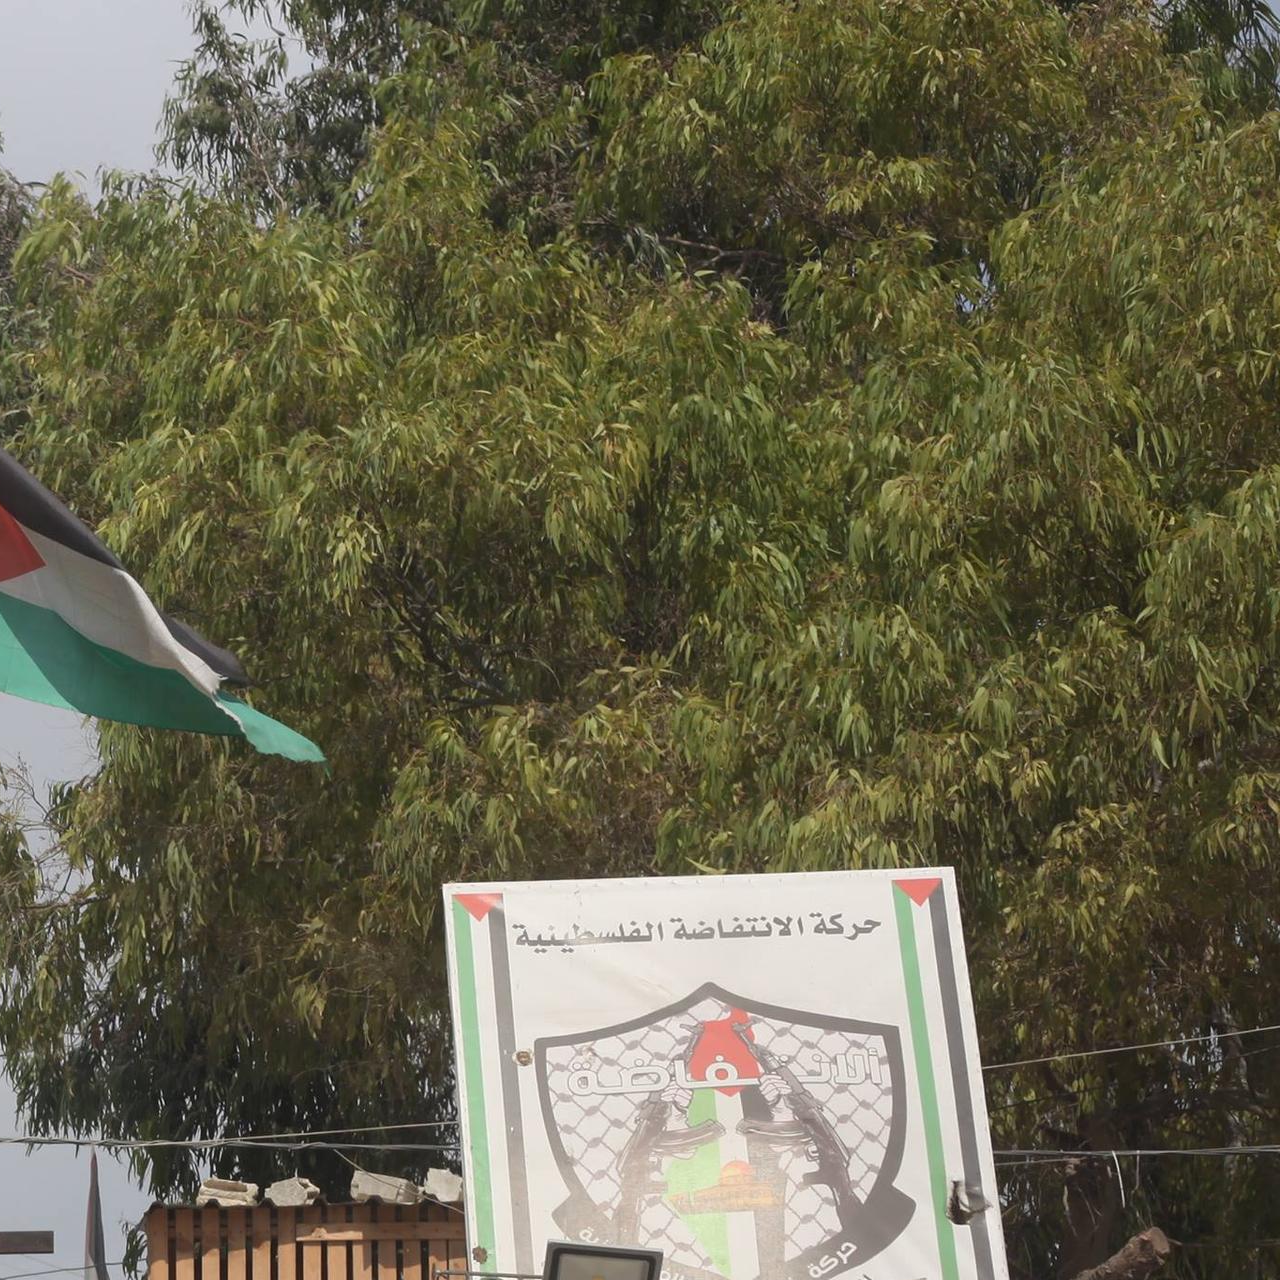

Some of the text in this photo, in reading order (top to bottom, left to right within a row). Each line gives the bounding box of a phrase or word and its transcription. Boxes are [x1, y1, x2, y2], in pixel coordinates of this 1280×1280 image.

[512, 911, 882, 955] حركة الانتفاضة الفلسطينية
[807, 1241, 858, 1279] حركة
